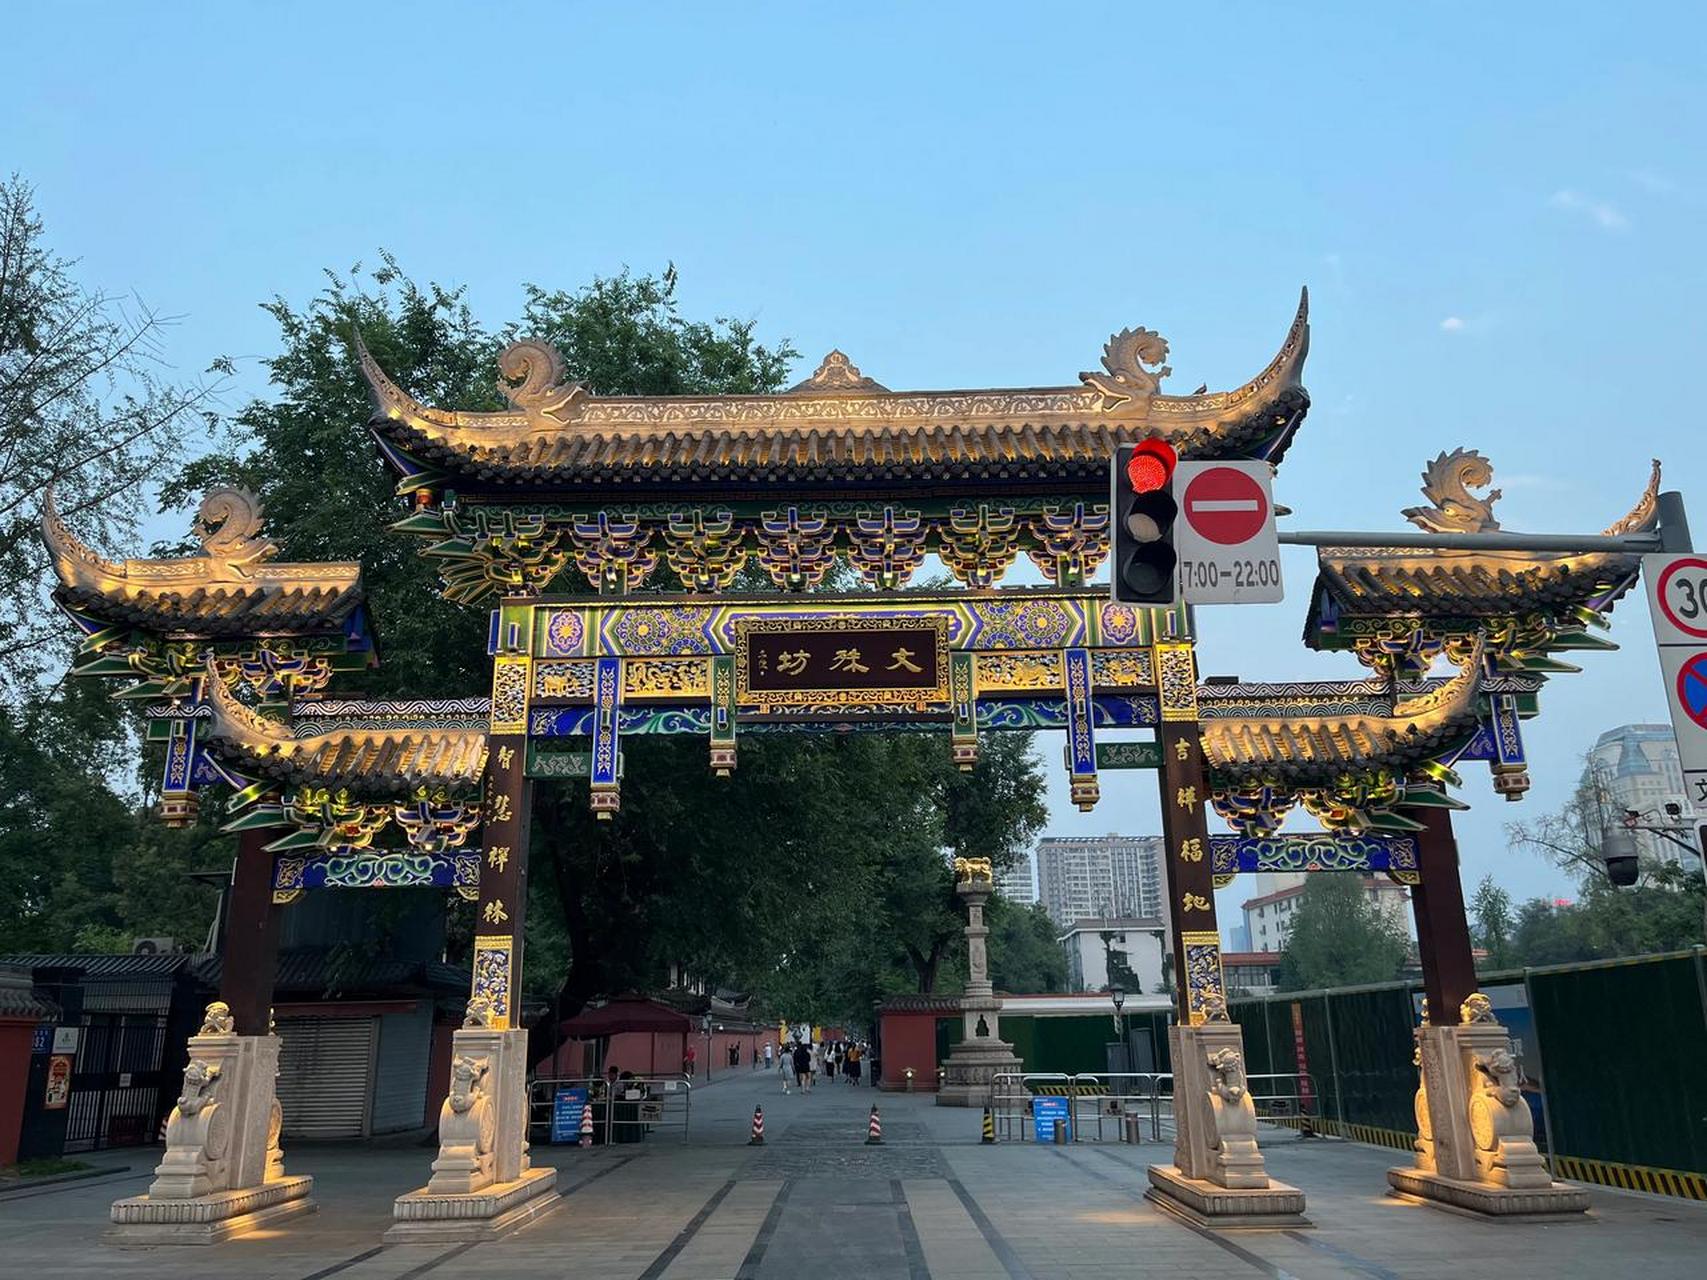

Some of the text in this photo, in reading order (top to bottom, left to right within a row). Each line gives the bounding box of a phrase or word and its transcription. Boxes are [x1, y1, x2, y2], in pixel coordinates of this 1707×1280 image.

[776, 648, 923, 676] 文殊坊
[1174, 737, 1211, 913] 吉祥福地
